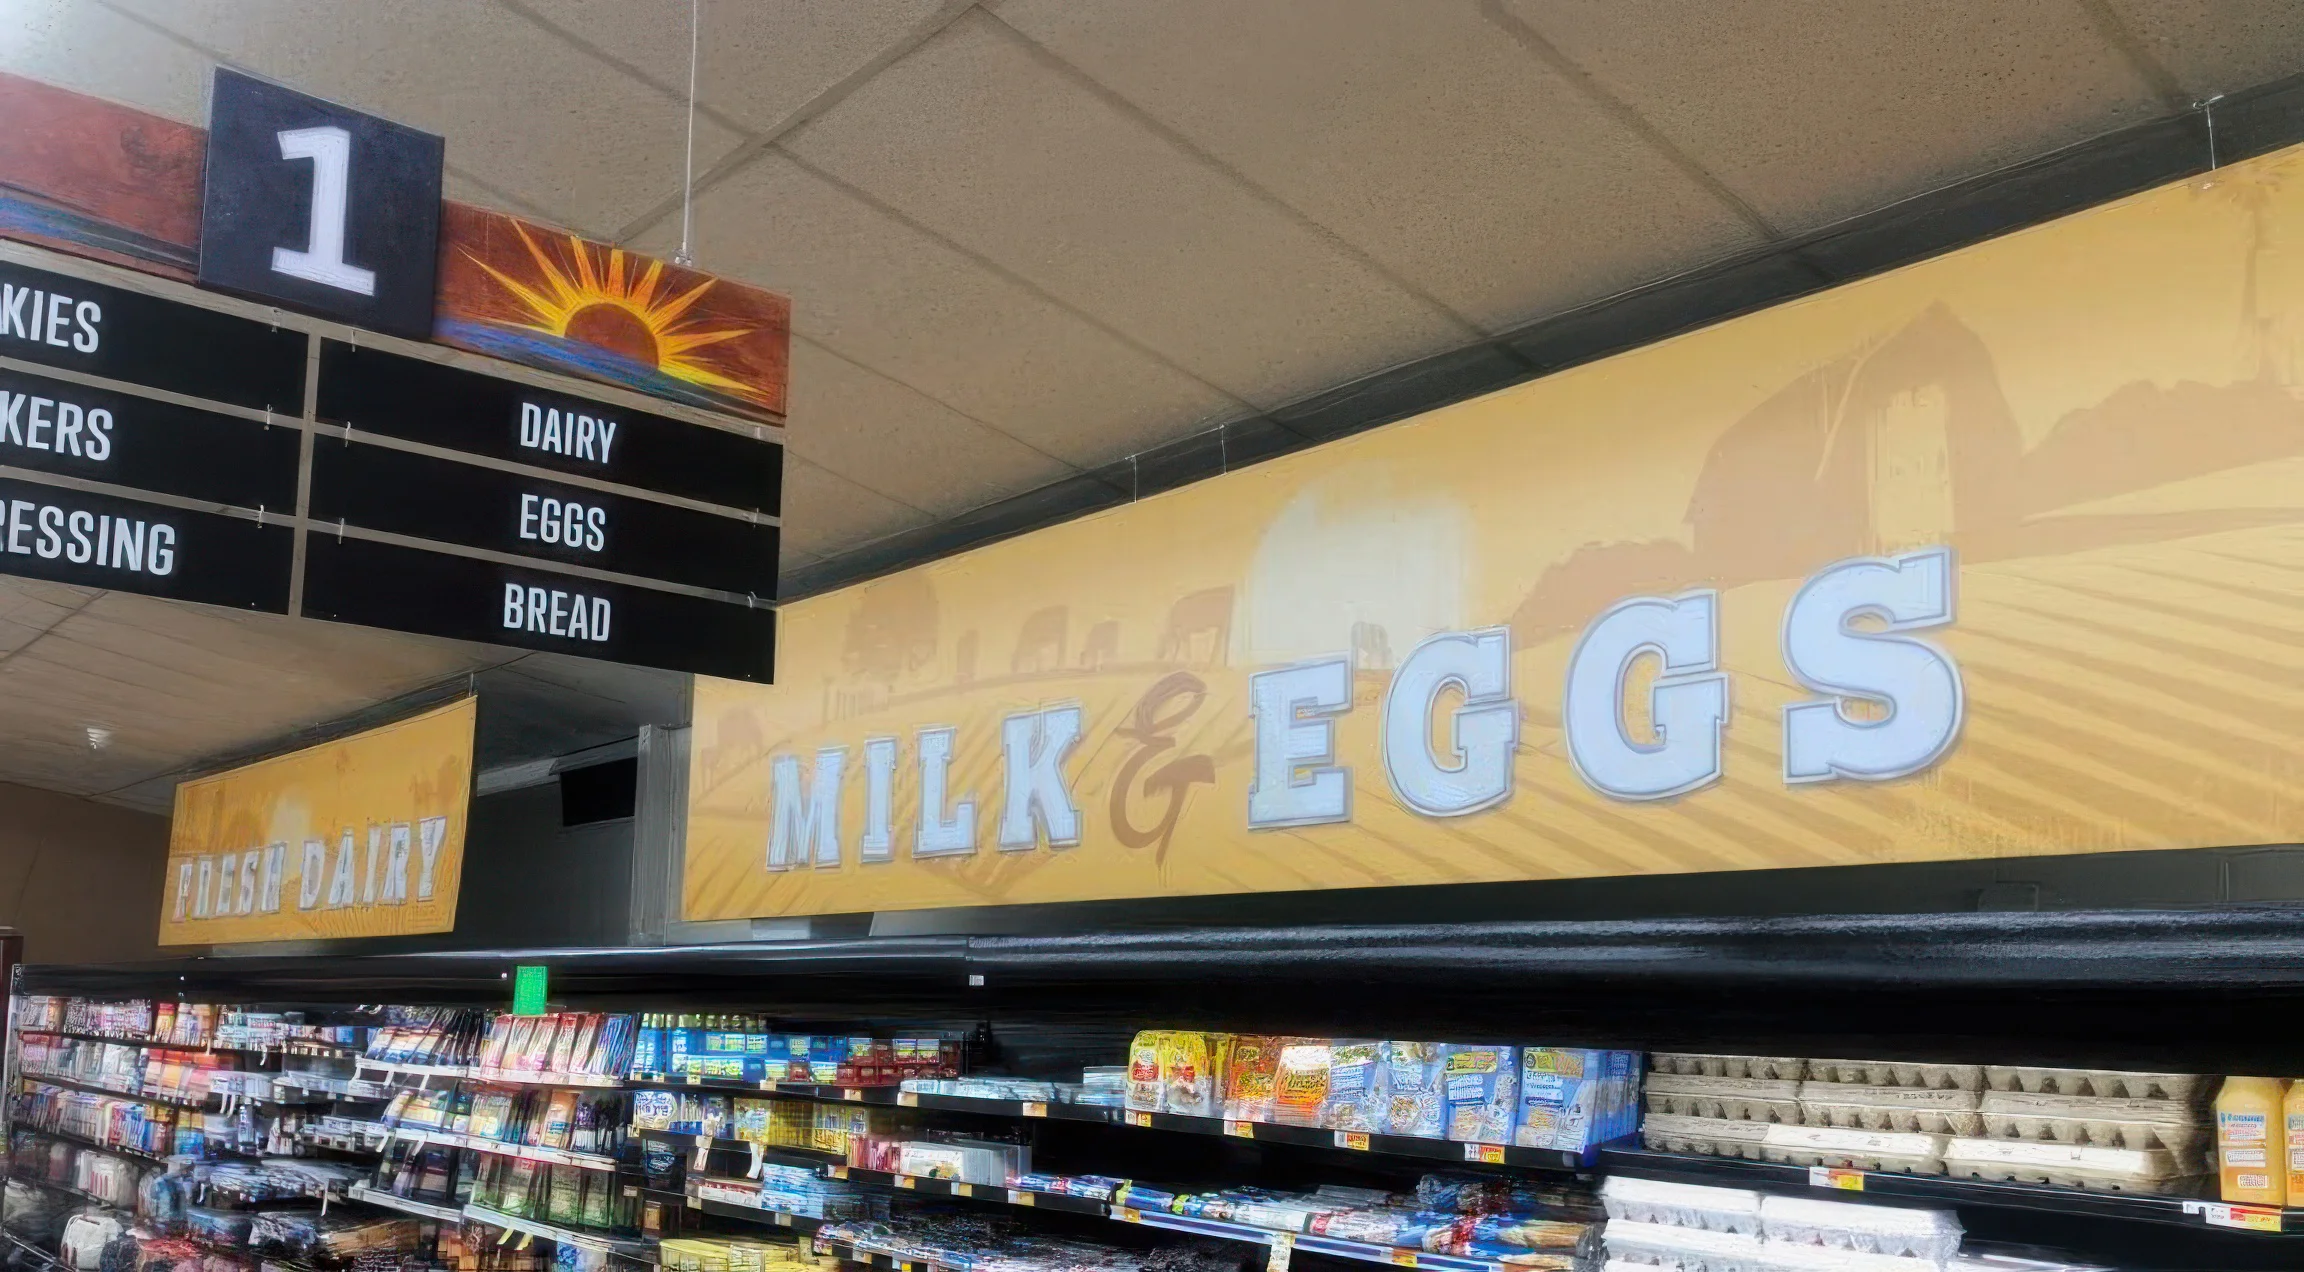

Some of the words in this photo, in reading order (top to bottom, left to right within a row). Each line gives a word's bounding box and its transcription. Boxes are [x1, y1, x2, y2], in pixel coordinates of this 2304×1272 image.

[271, 126, 376, 296] 1
[0, 283, 101, 353] KIES
[0, 390, 113, 461] KERS
[520, 402, 617, 465] DAIRY
[520, 494, 606, 553] EGGS
[503, 582, 611, 643] BREAD
[766, 699, 1085, 871] MILK
[1110, 671, 1216, 868] &
[1247, 546, 1965, 829] EGGS
[299, 816, 447, 911] DAIRY
